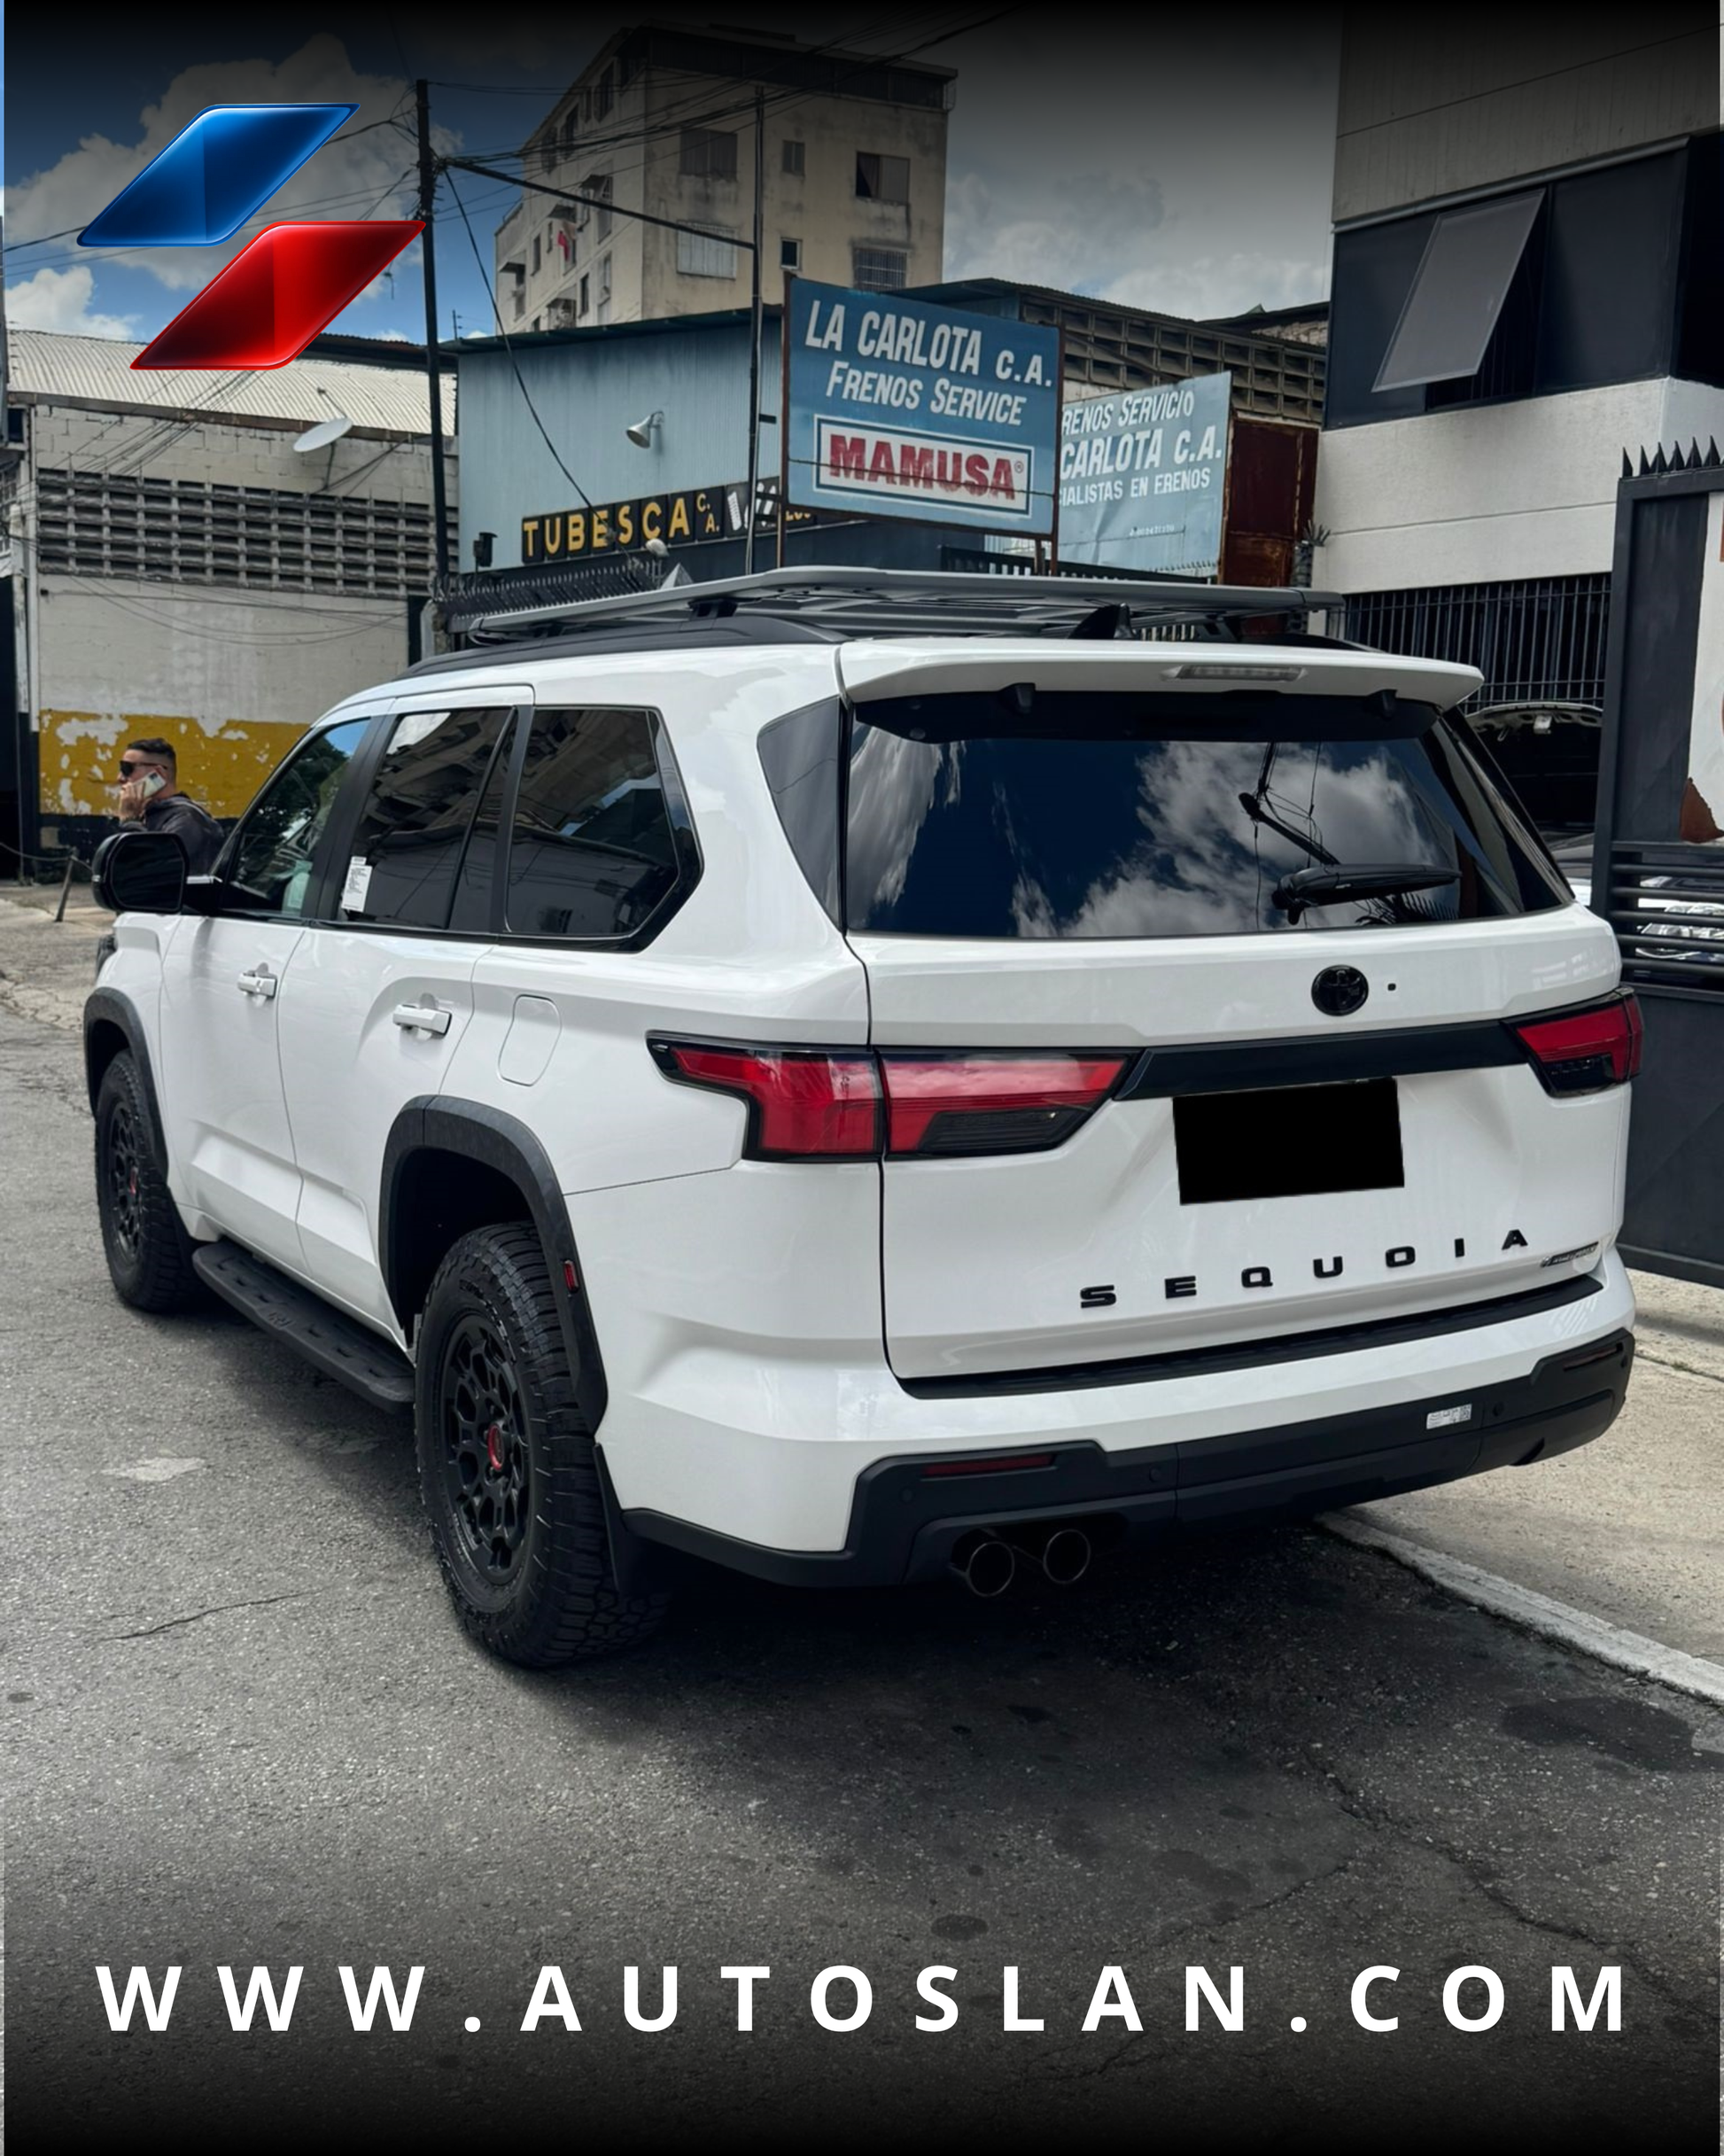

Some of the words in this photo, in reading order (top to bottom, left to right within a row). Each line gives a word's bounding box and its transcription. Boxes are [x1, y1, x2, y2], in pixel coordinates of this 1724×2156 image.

[805, 300, 845, 352] LA
[858, 310, 982, 376] CARLOTA
[995, 349, 1052, 387] C.A.
[826, 360, 923, 410] FRENOS
[930, 377, 1027, 425] SERVICE
[1061, 404, 1114, 436] RENOS
[1118, 390, 1195, 427] SERVICIO
[1060, 427, 1163, 481] CARLOTA
[1173, 425, 1223, 465] C.A.
[1130, 476, 1149, 498] EN
[523, 496, 691, 557] TUBESCA
[1080, 1229, 1528, 1309] SEQUOIA
